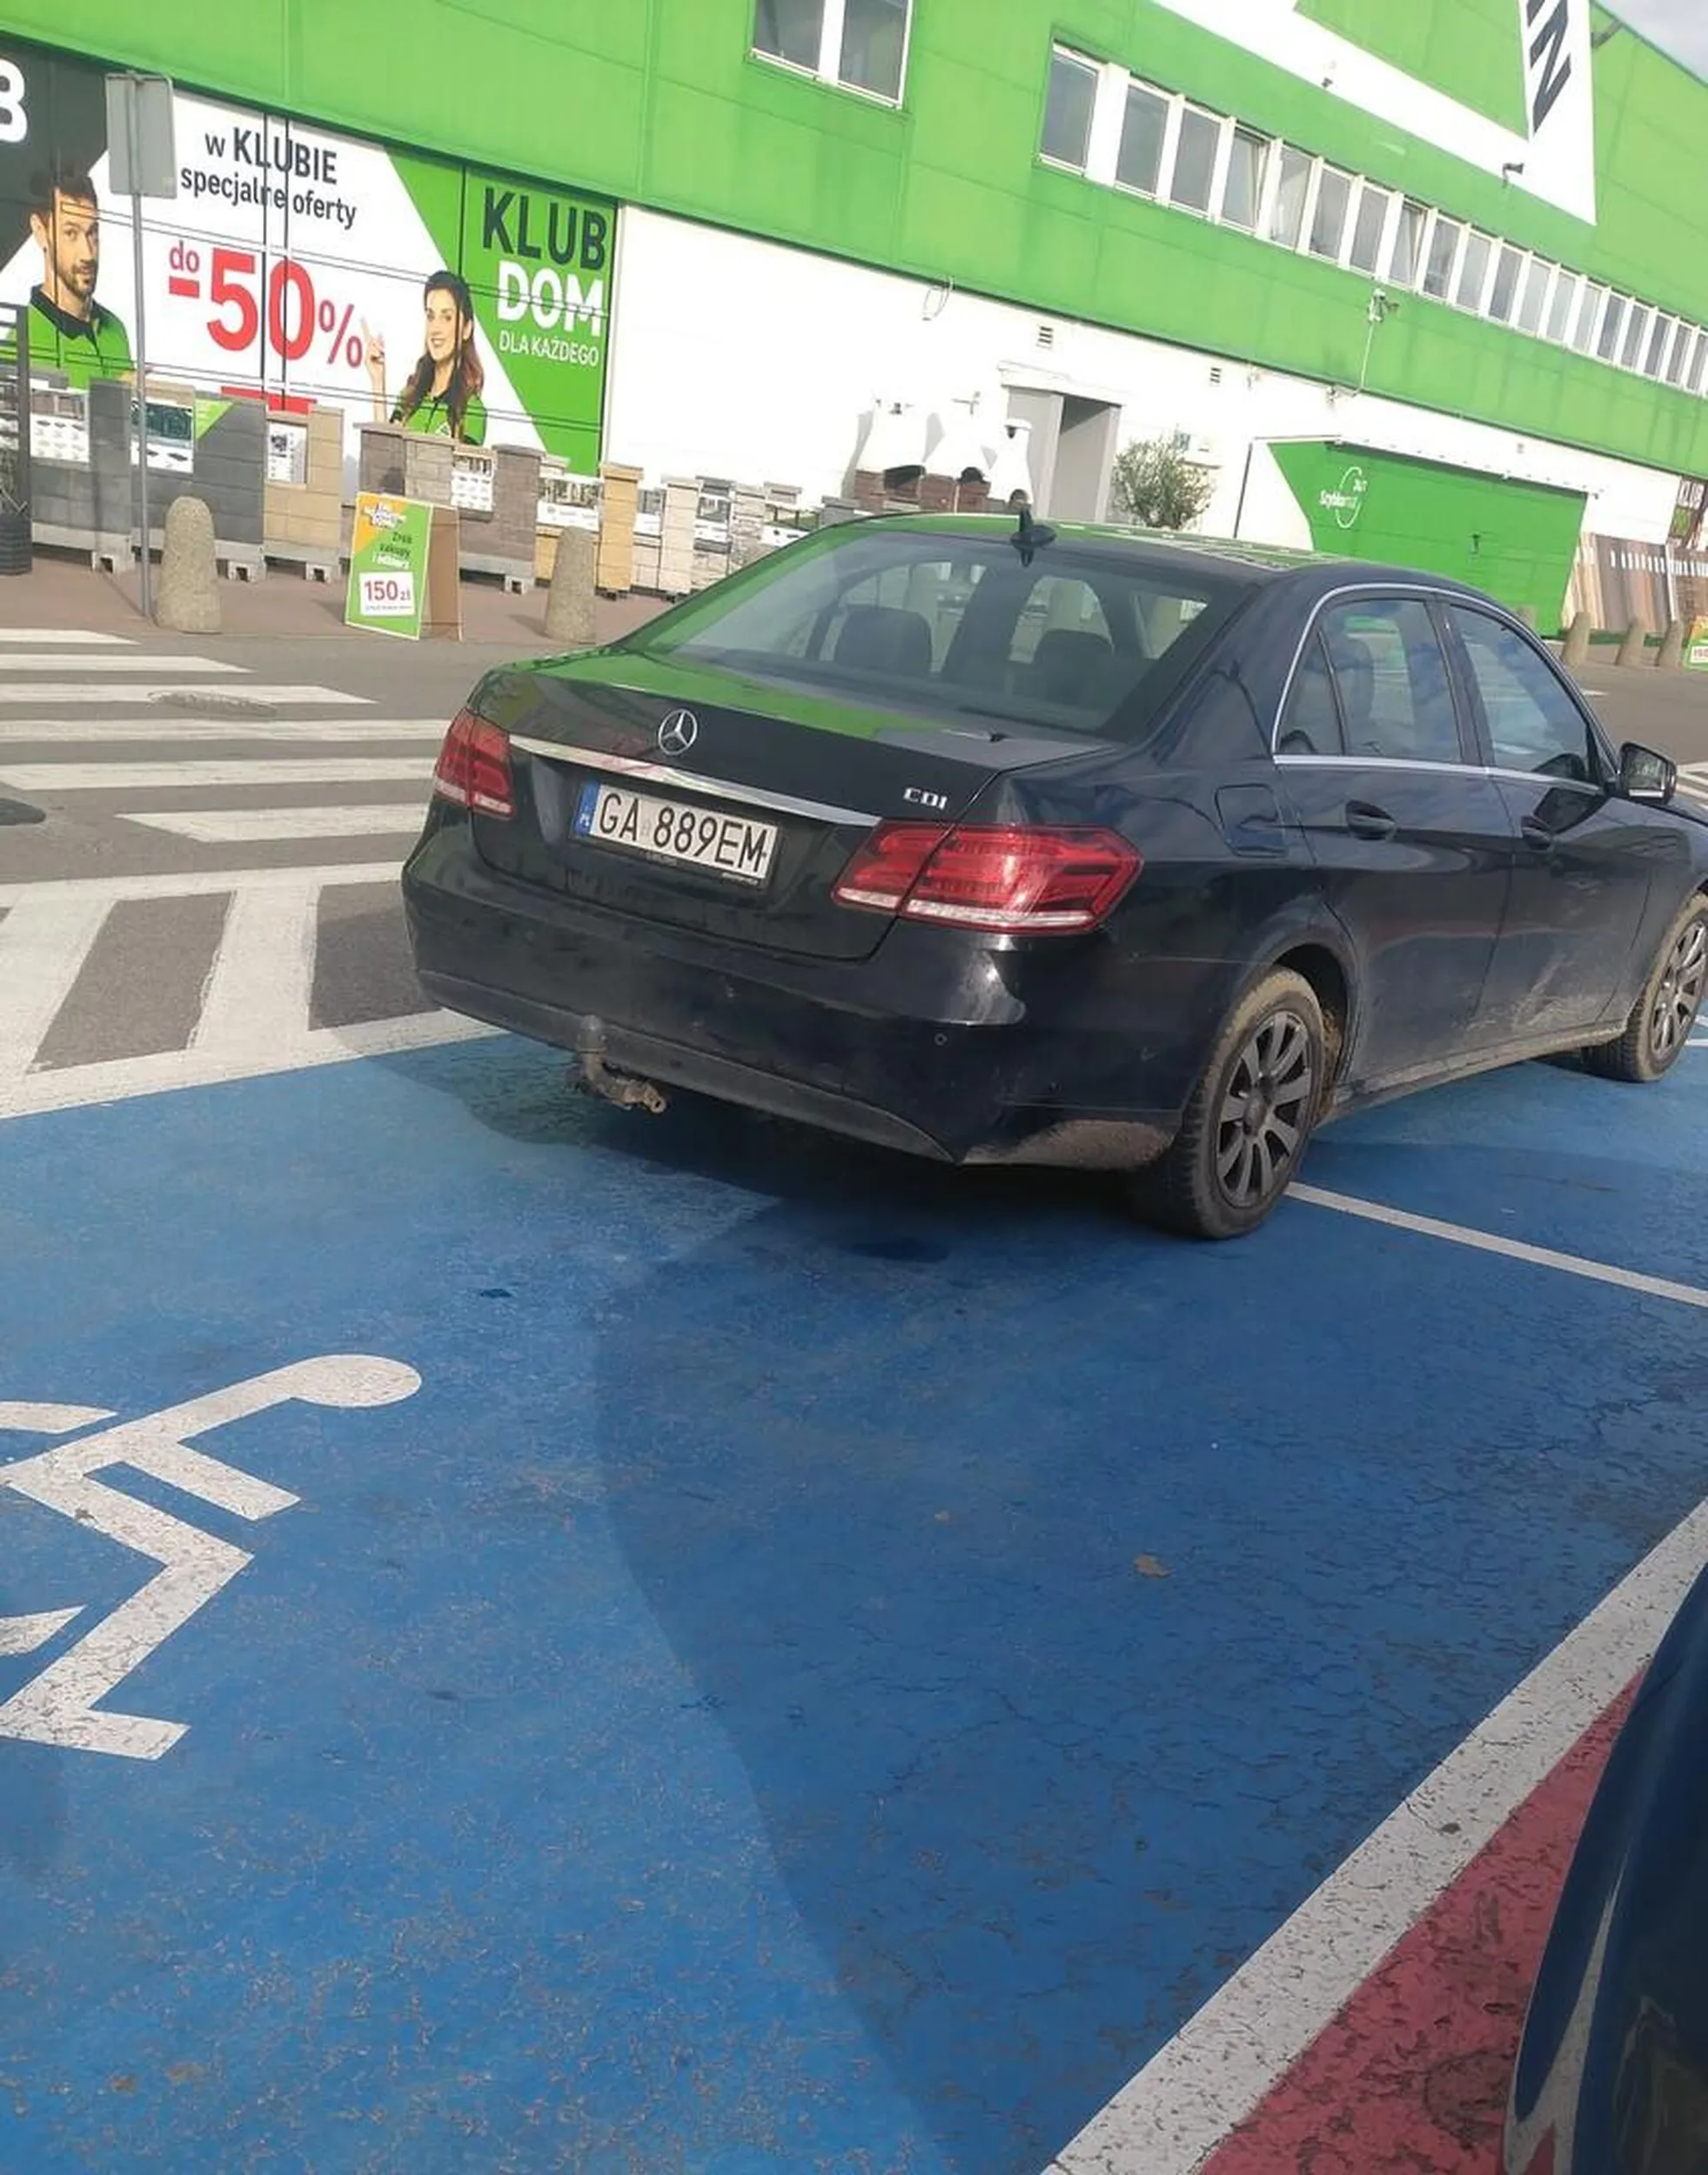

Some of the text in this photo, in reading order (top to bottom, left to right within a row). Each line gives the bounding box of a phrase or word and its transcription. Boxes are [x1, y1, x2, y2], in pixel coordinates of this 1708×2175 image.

[1526, 0, 1571, 134] N
[204, 127, 337, 184] w KLUBIE
[180, 167, 357, 230] specjalne oferty
[170, 239, 200, 273] do
[483, 187, 607, 271] KLUB
[497, 259, 604, 338] DOM
[499, 330, 599, 366] DLA KAŻDEGO
[364, 579, 398, 601] 150
[903, 787, 948, 810] CDI
[599, 793, 767, 873] GA 889EM
